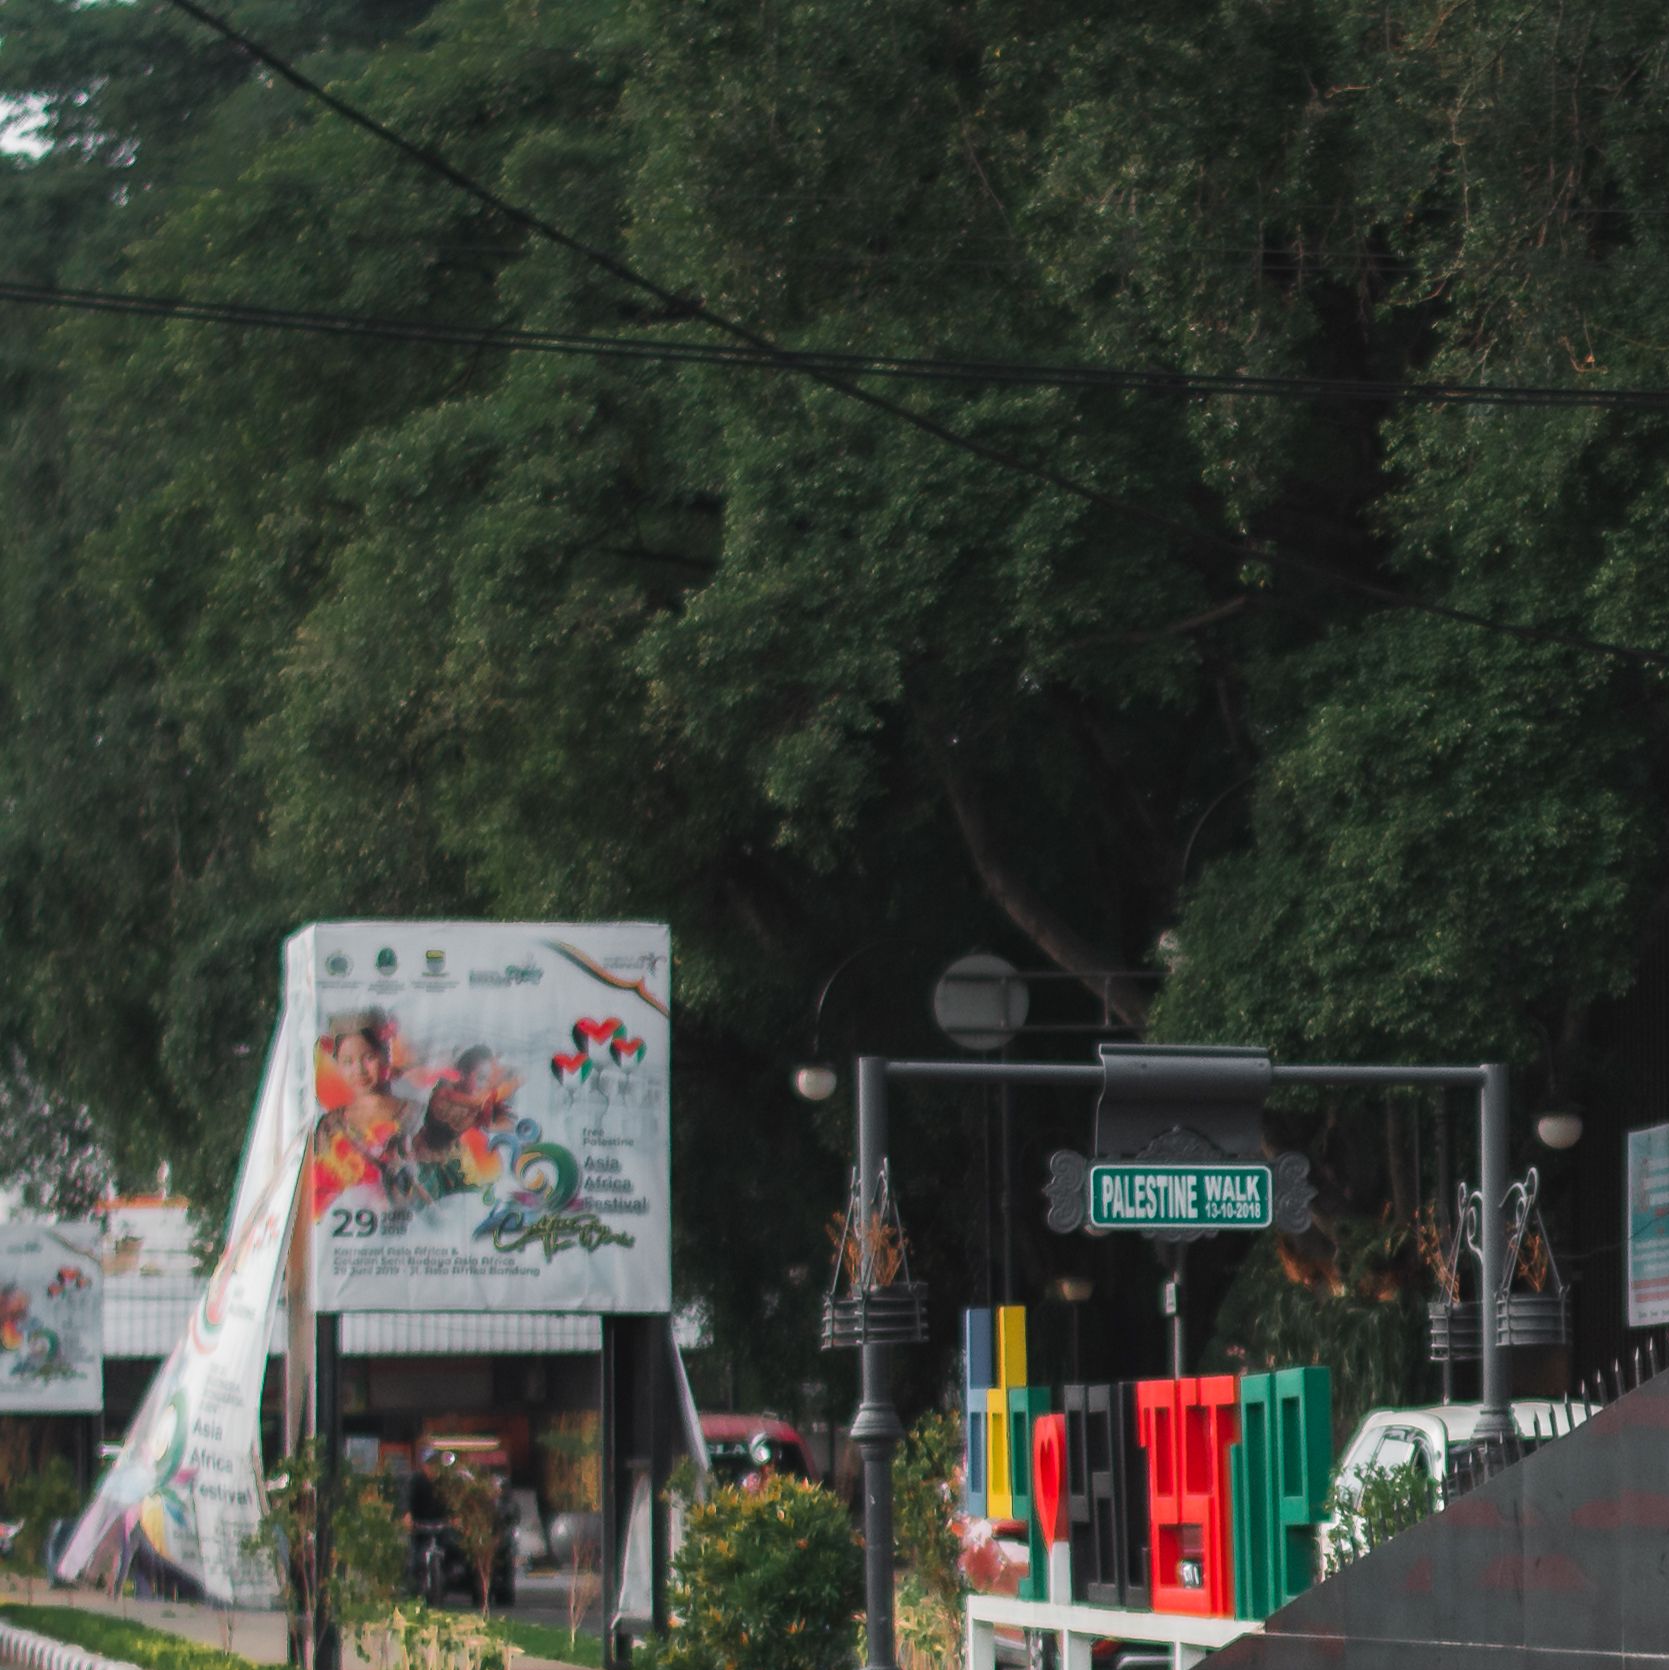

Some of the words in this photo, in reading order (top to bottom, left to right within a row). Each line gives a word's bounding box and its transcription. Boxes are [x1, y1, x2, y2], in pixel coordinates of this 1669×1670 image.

[583, 1155, 622, 1172] Asia
[583, 1176, 633, 1192] Africa
[1101, 1174, 1199, 1219] PALESTINE
[1204, 1175, 1261, 1201] WALK
[1204, 1202, 1261, 1219] 13-10-2018
[331, 1207, 378, 1238] 29
[193, 1416, 224, 1441] Asia
